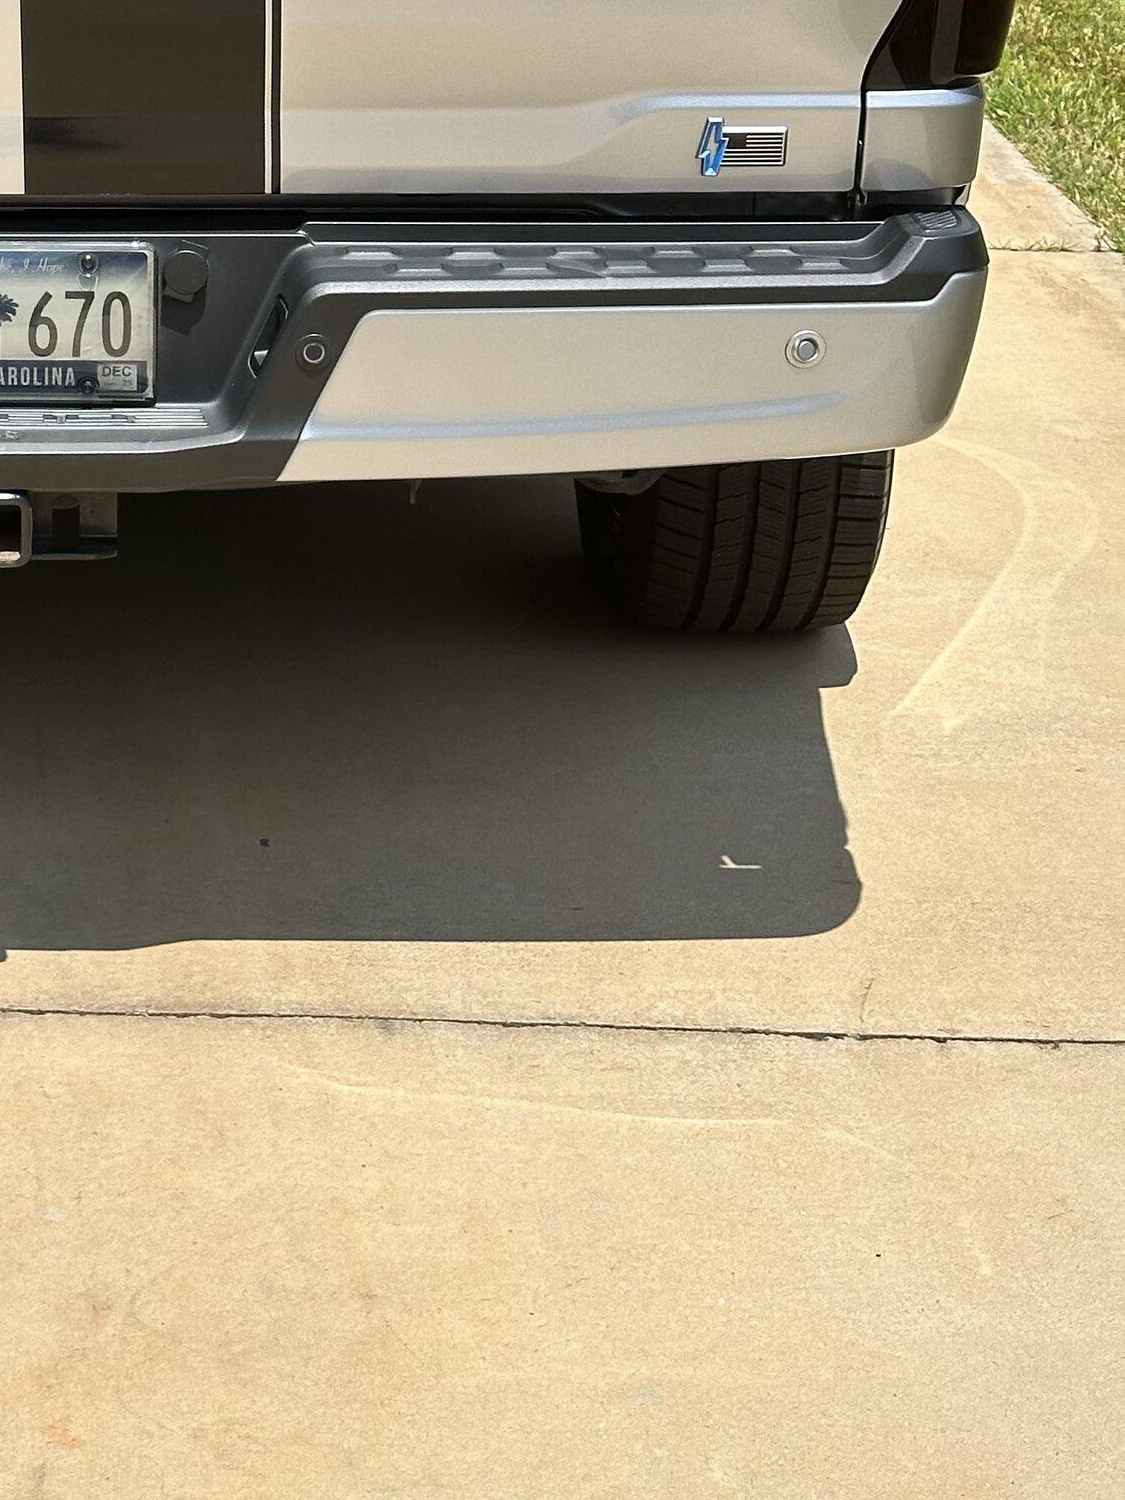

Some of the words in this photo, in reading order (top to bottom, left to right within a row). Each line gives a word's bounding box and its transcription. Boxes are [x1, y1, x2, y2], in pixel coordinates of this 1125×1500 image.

[18, 258, 29, 274] I
[28, 291, 132, 357] 670
[102, 365, 132, 377] DEC
